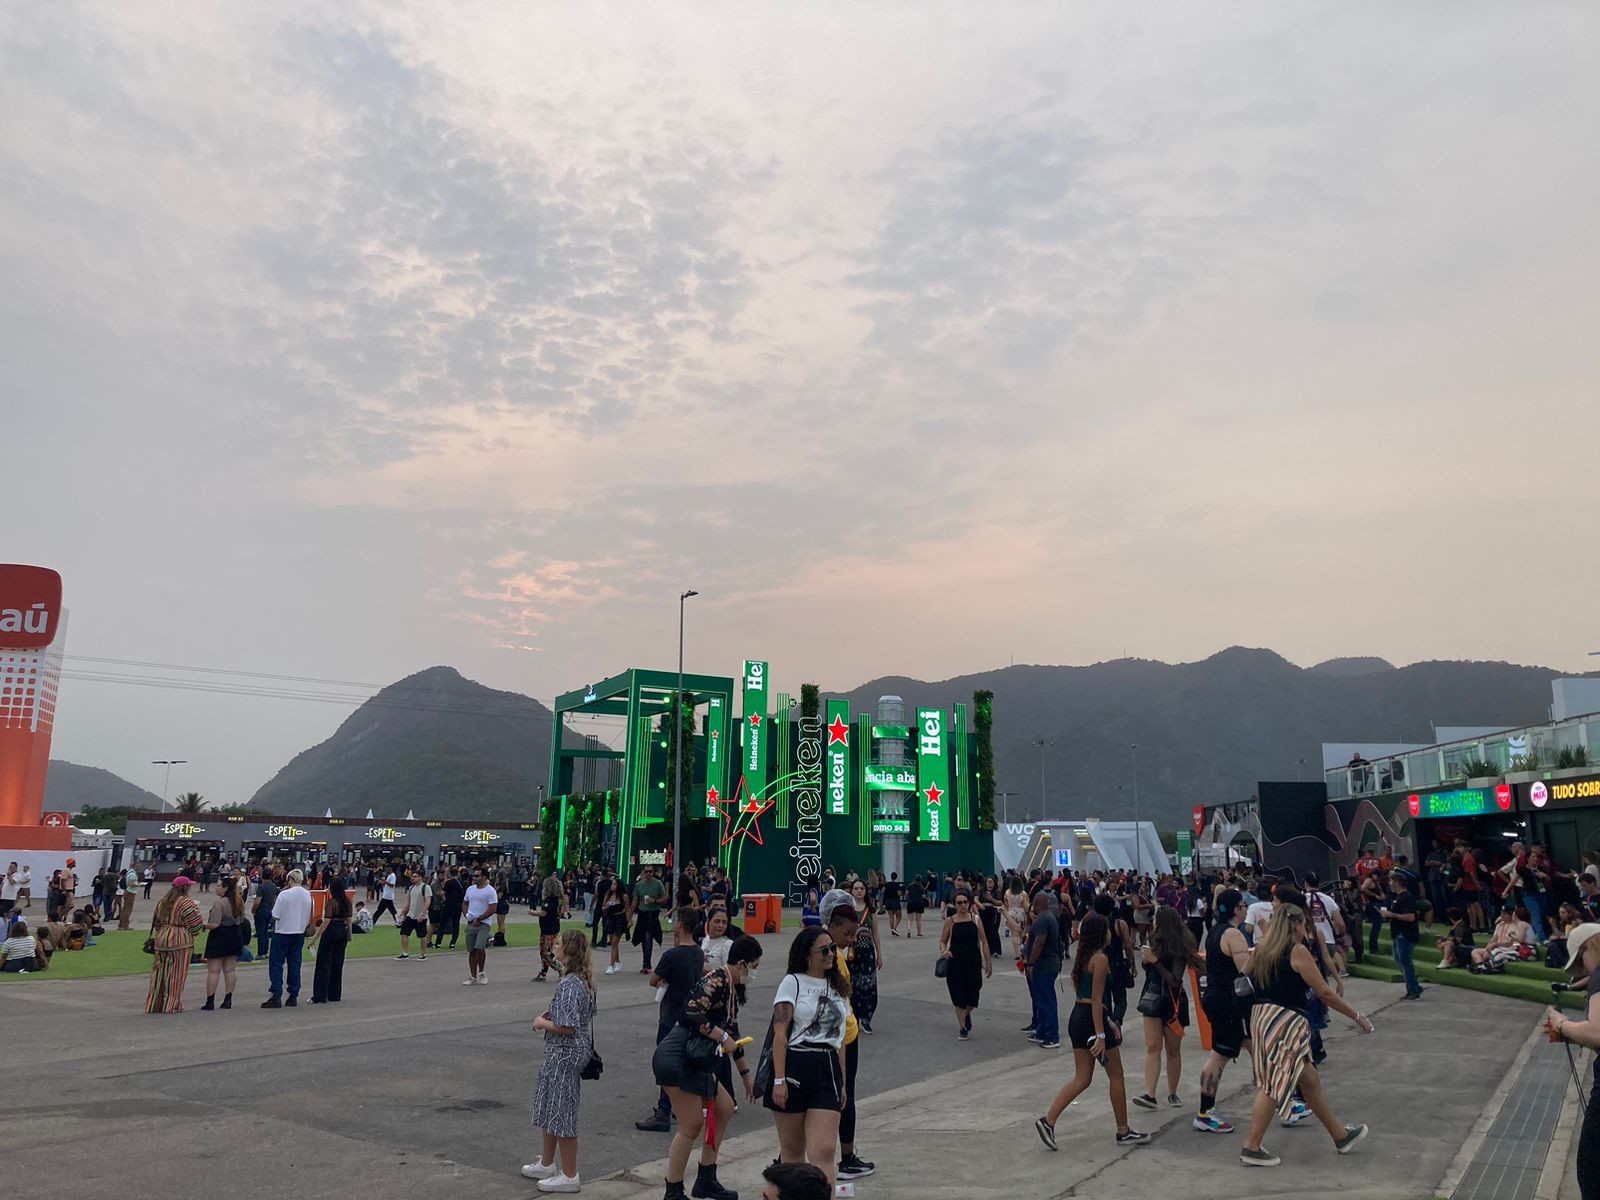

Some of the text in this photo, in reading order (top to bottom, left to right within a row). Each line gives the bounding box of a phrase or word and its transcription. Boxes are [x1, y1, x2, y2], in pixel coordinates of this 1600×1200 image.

[0, 603, 48, 634] aú
[920, 710, 941, 756] Hei
[1552, 784, 1576, 799] TUDO
[1006, 824, 1035, 835] WC
